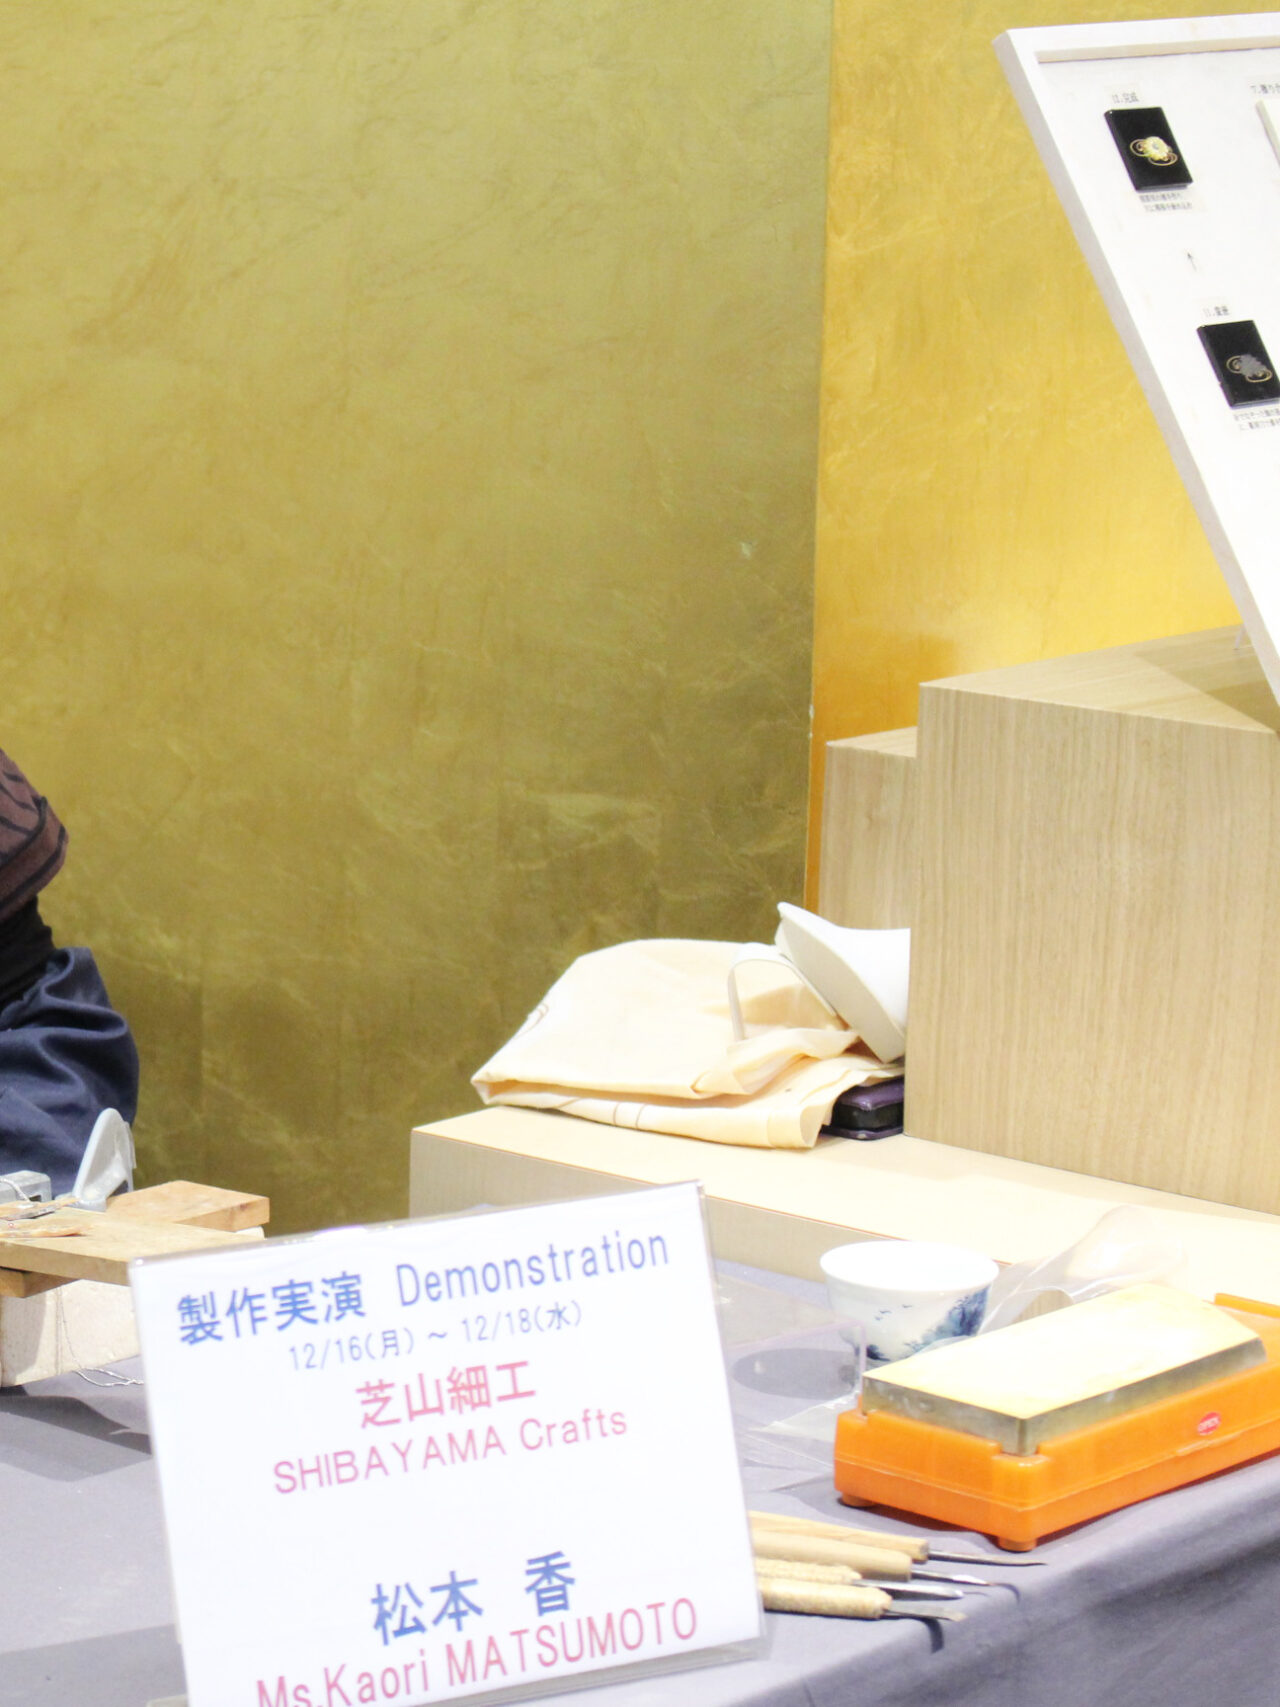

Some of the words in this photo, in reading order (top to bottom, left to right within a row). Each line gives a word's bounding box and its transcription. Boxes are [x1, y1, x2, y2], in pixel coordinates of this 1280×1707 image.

[177, 1271, 367, 1346] 製作実演
[396, 1230, 669, 1307] Demonstration
[289, 1327, 415, 1371] 12/16(月)
[461, 1300, 582, 1343] 12/18(水)
[356, 1361, 537, 1429] 芝山細工
[274, 1425, 507, 1494] SHIBAYAMA
[520, 1409, 627, 1451] Crafts
[371, 1571, 485, 1646] 松本
[525, 1551, 577, 1618] 香
[446, 1598, 697, 1686] MATSUMOTO
